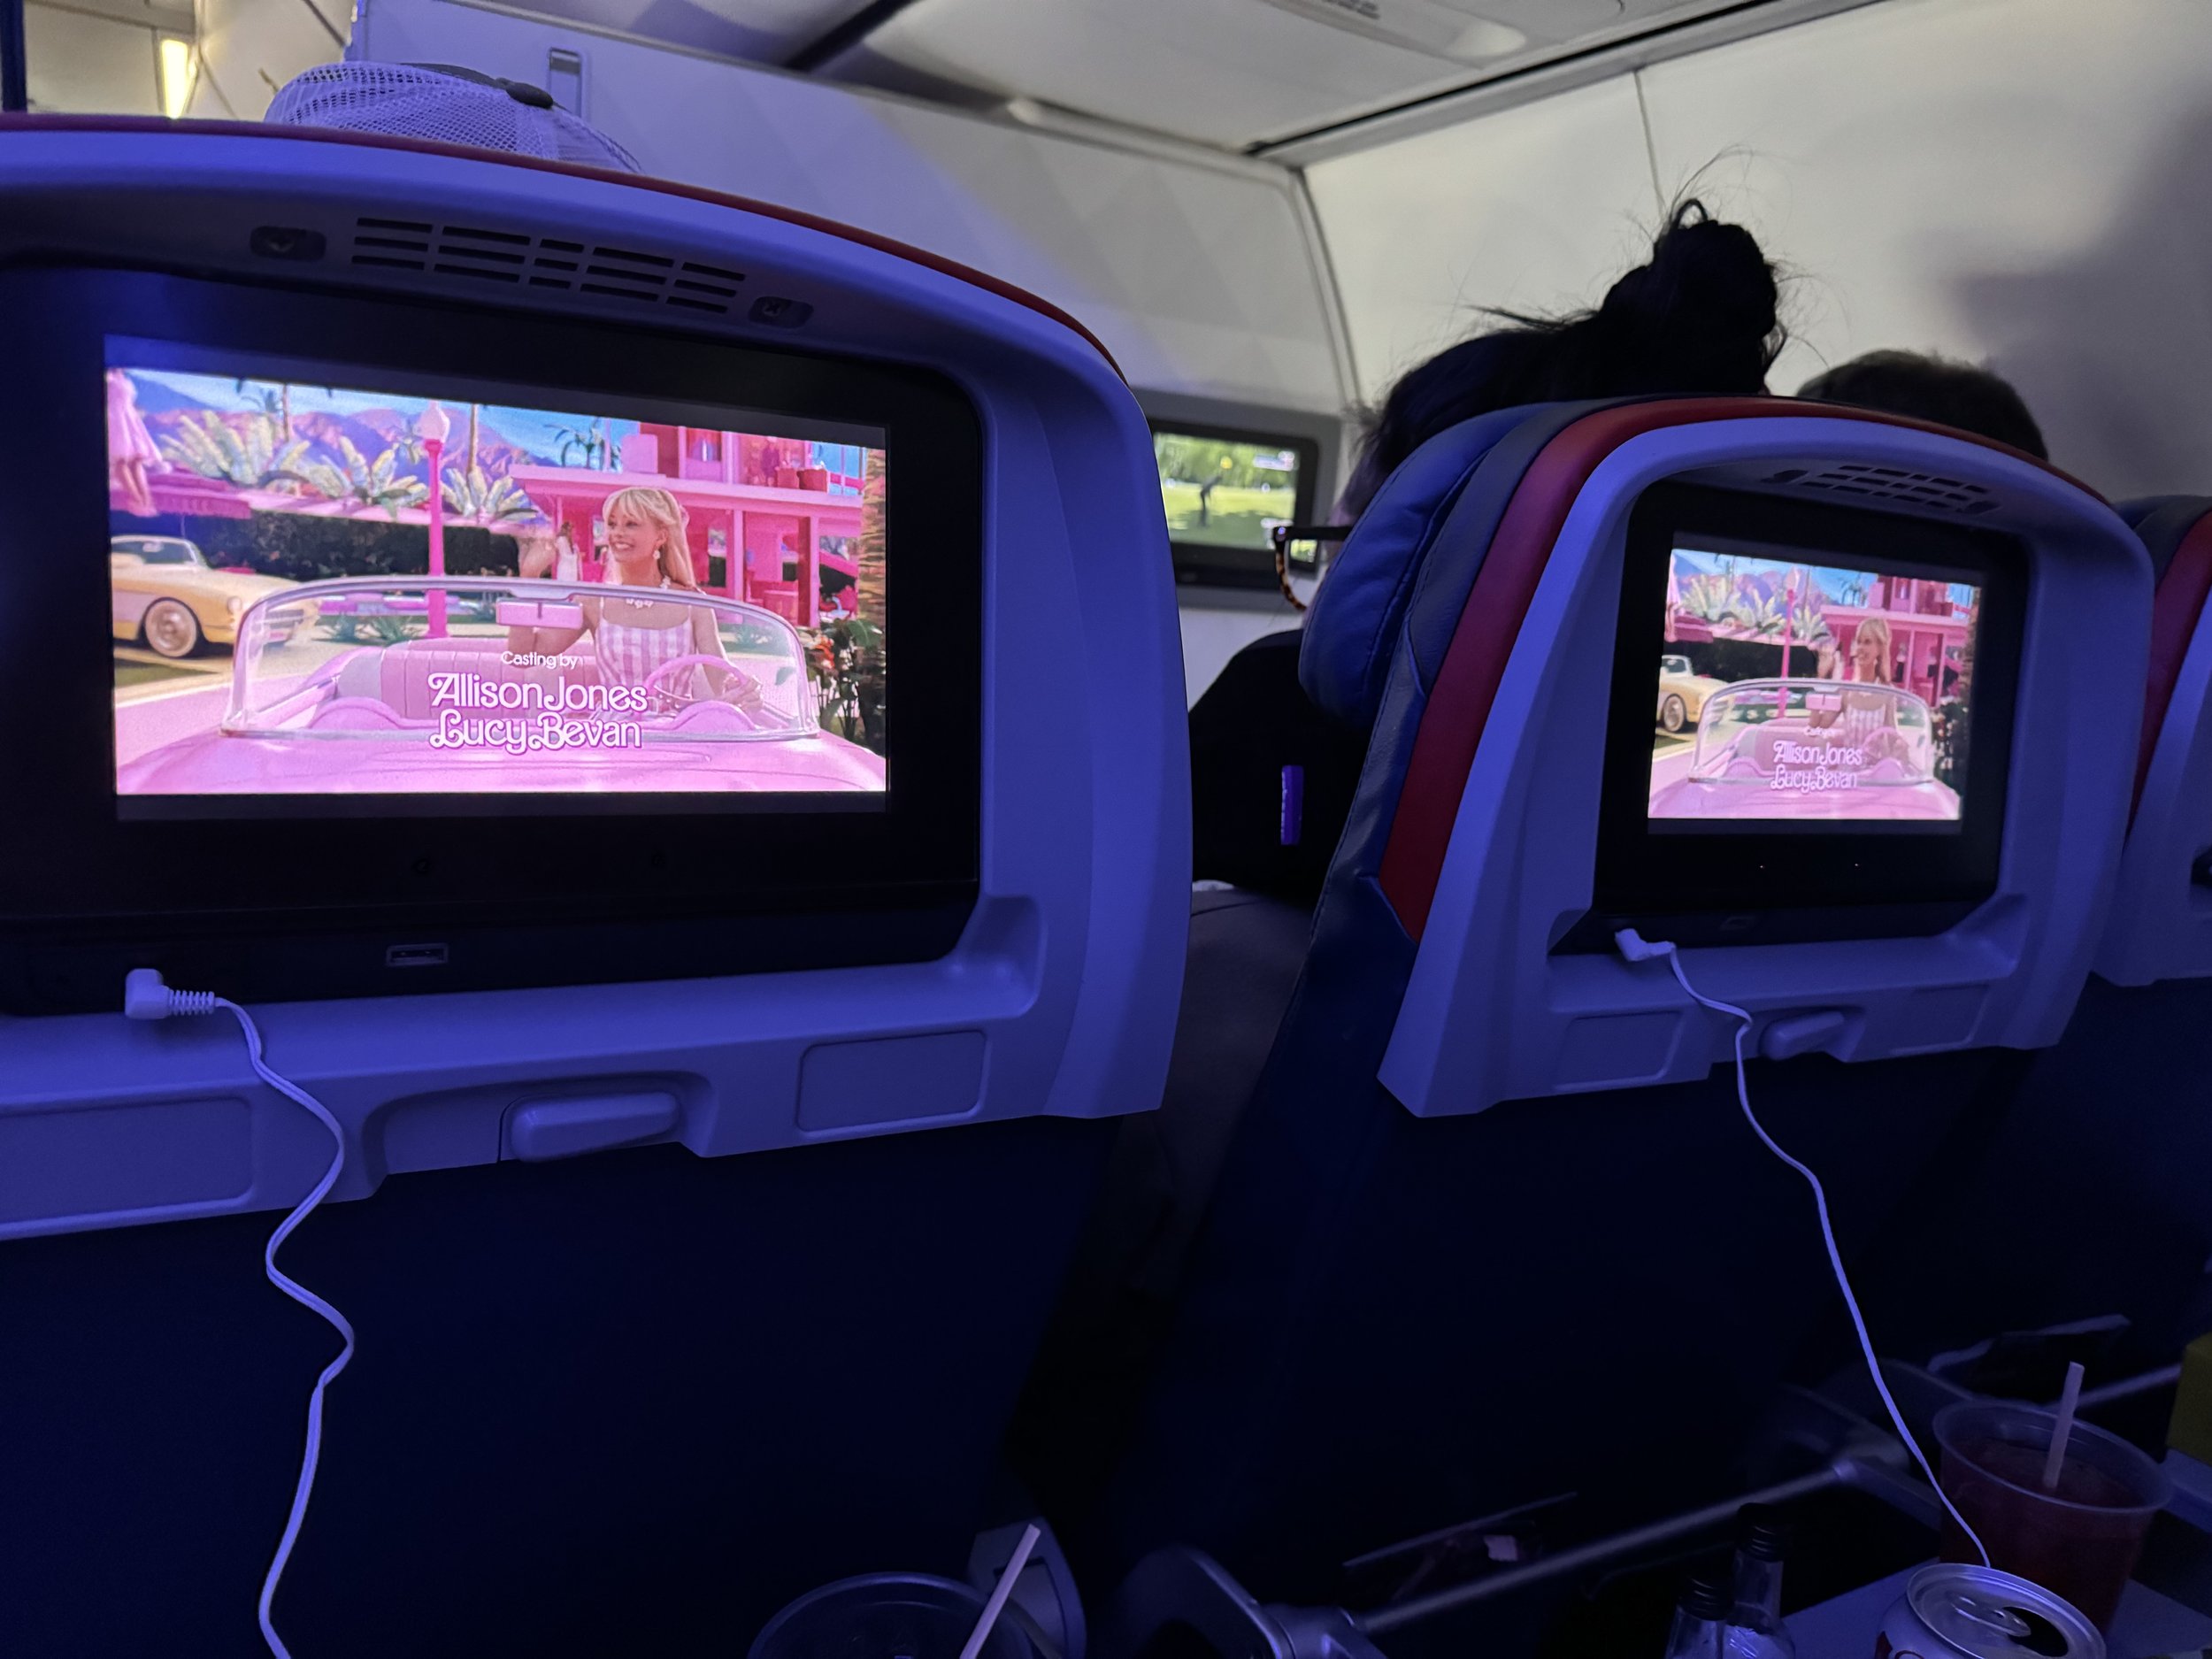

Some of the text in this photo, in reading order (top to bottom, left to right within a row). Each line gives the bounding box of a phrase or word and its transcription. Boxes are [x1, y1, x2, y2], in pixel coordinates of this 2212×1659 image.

[500, 651, 579, 670] Casting by
[427, 672, 649, 711] Allison Jones
[429, 709, 641, 755] Lucy Bevan
[1773, 740, 1863, 765] Allison Jones
[1770, 764, 1857, 793] Lucy Bevan
